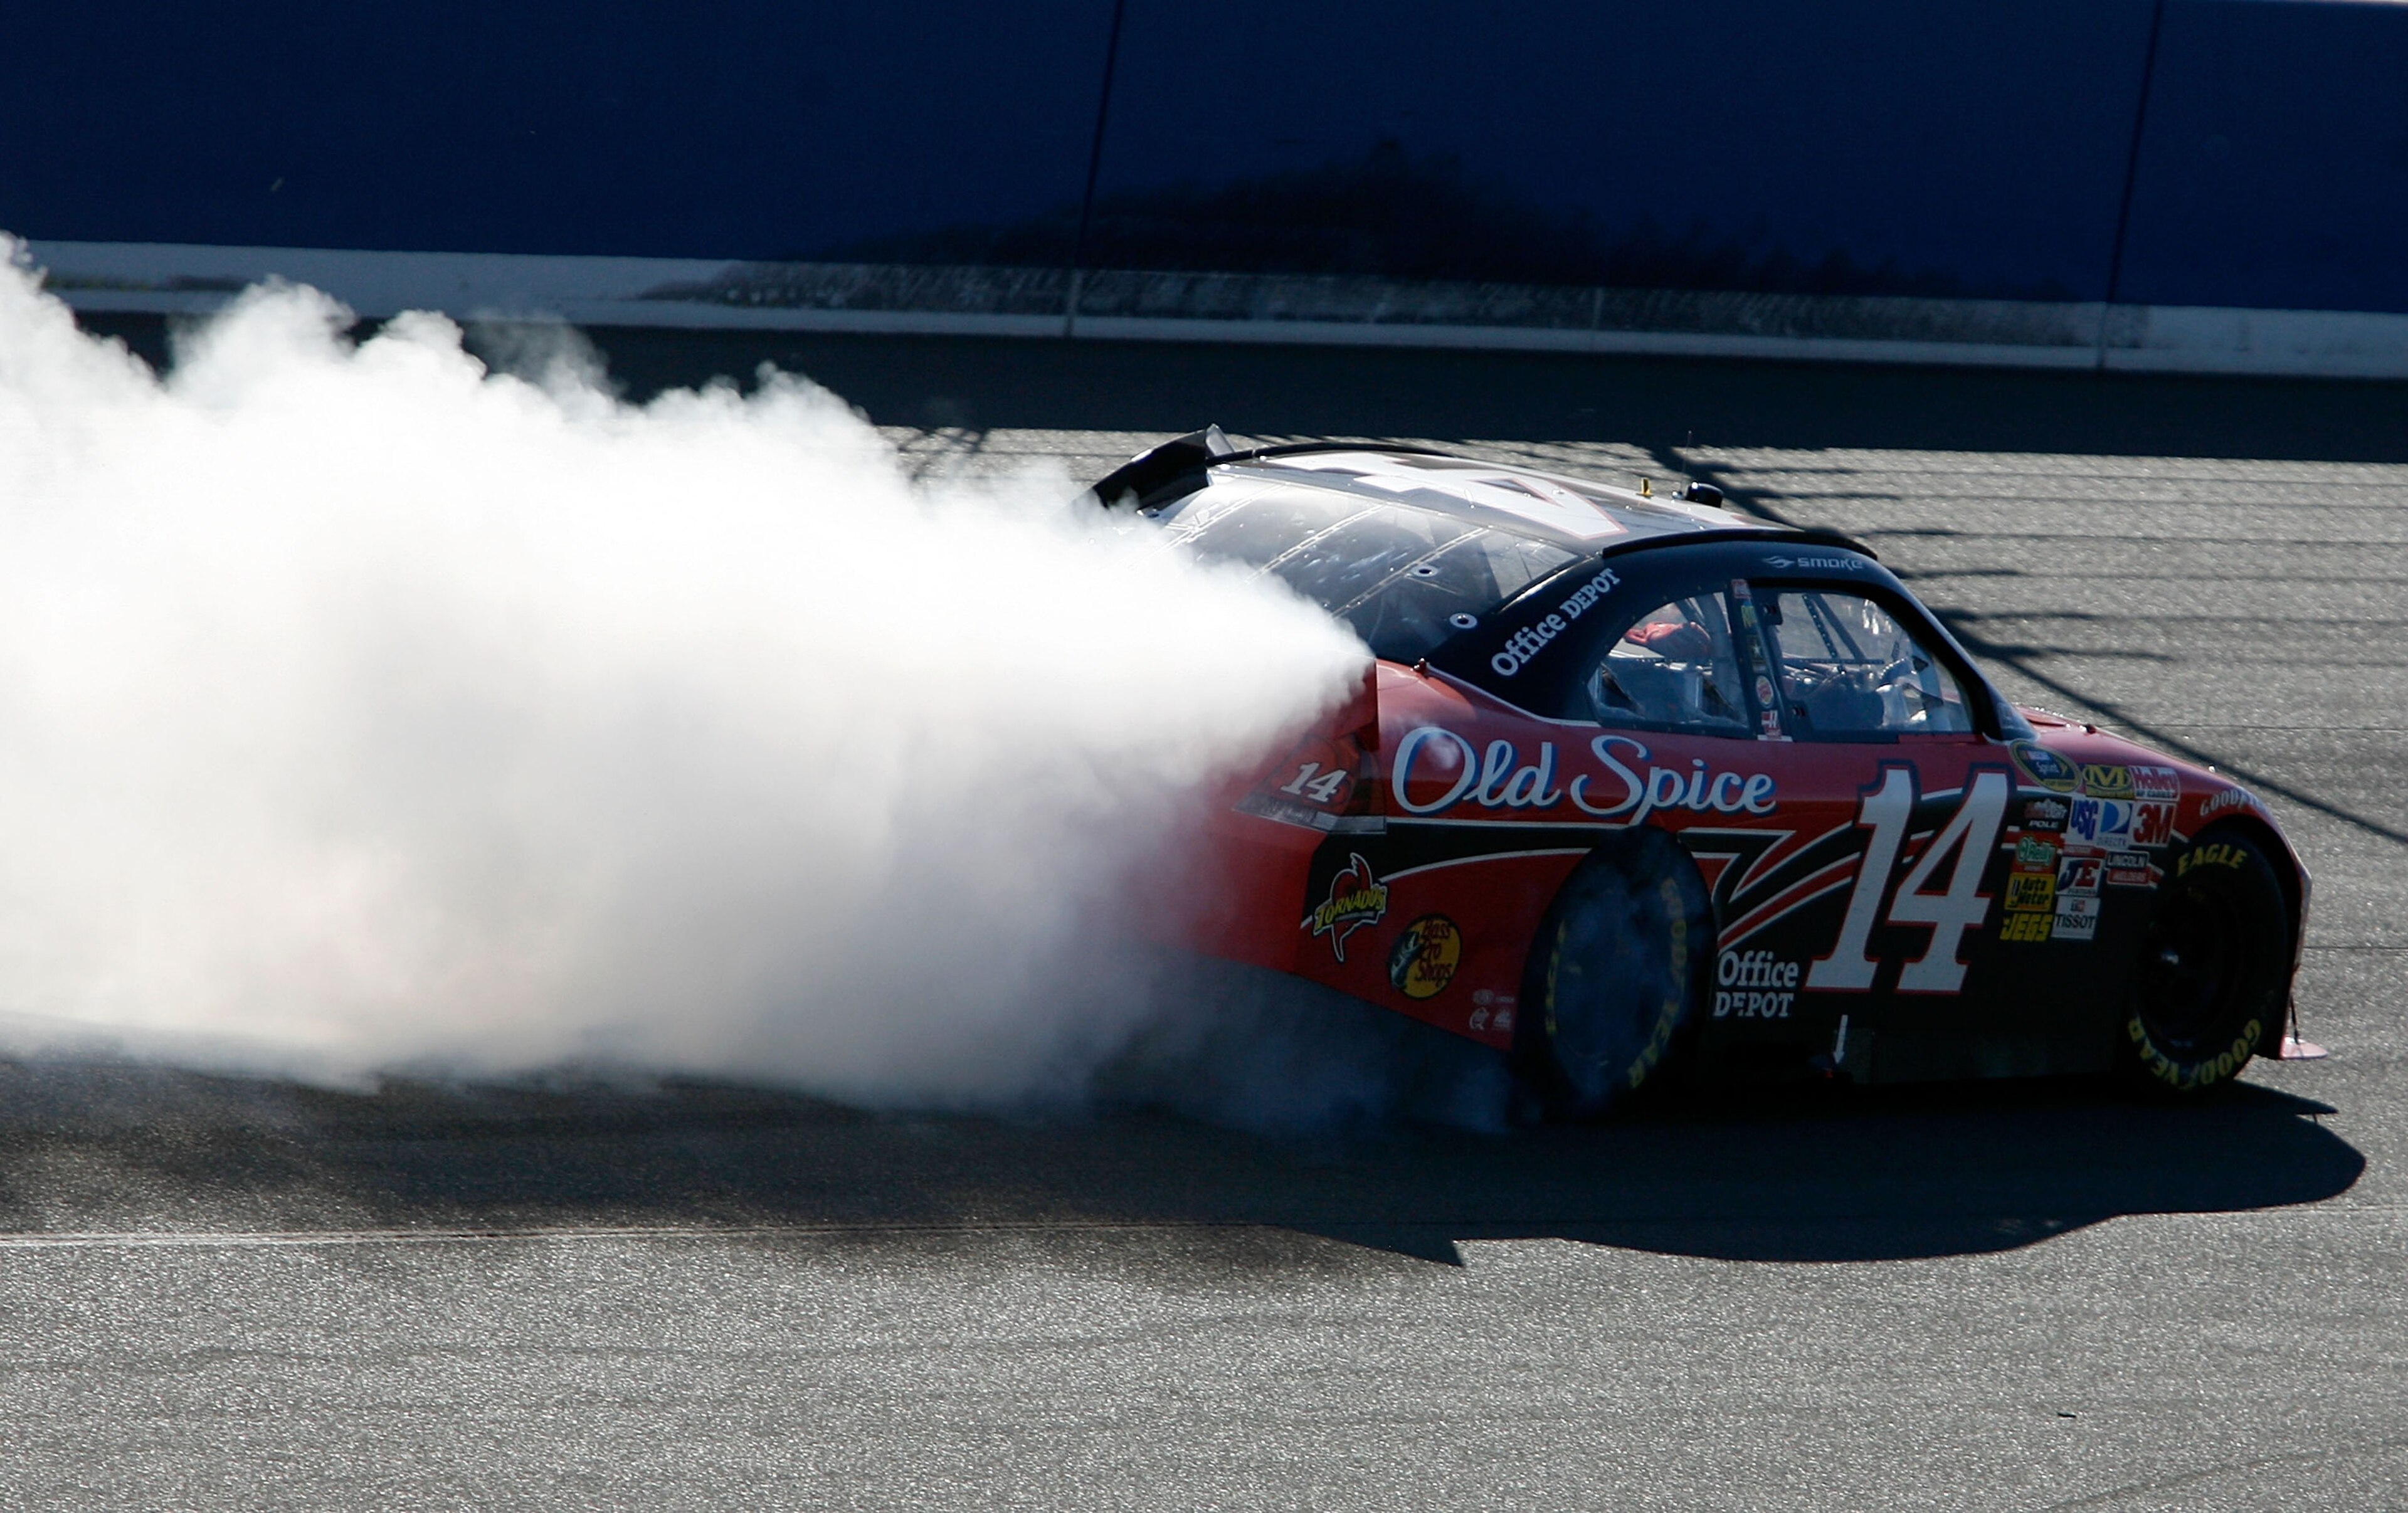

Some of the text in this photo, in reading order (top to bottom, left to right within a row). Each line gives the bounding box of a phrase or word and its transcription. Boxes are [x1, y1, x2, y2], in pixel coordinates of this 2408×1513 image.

[1491, 567, 1621, 677] Office DEPOT
[1280, 761, 1348, 803] 14
[1392, 726, 1776, 826] Old Spice
[2029, 820, 2059, 828] POLE
[2071, 800, 2098, 840] USG
[2134, 803, 2174, 843] 3M
[2108, 853, 2147, 870] LINCOLN
[2177, 843, 2248, 877] EAGLE
[1803, 766, 2009, 993] 14
[2022, 877, 2047, 892] Auto
[1314, 888, 1385, 931] TORNADOS
[2056, 914, 2096, 929] TISSOT
[1422, 919, 1450, 939] Bass
[1999, 913, 2054, 942] JEGS
[1415, 959, 1452, 988] Shops
[1718, 949, 1800, 988] Office
[1711, 991, 1795, 1018] DEPOT
